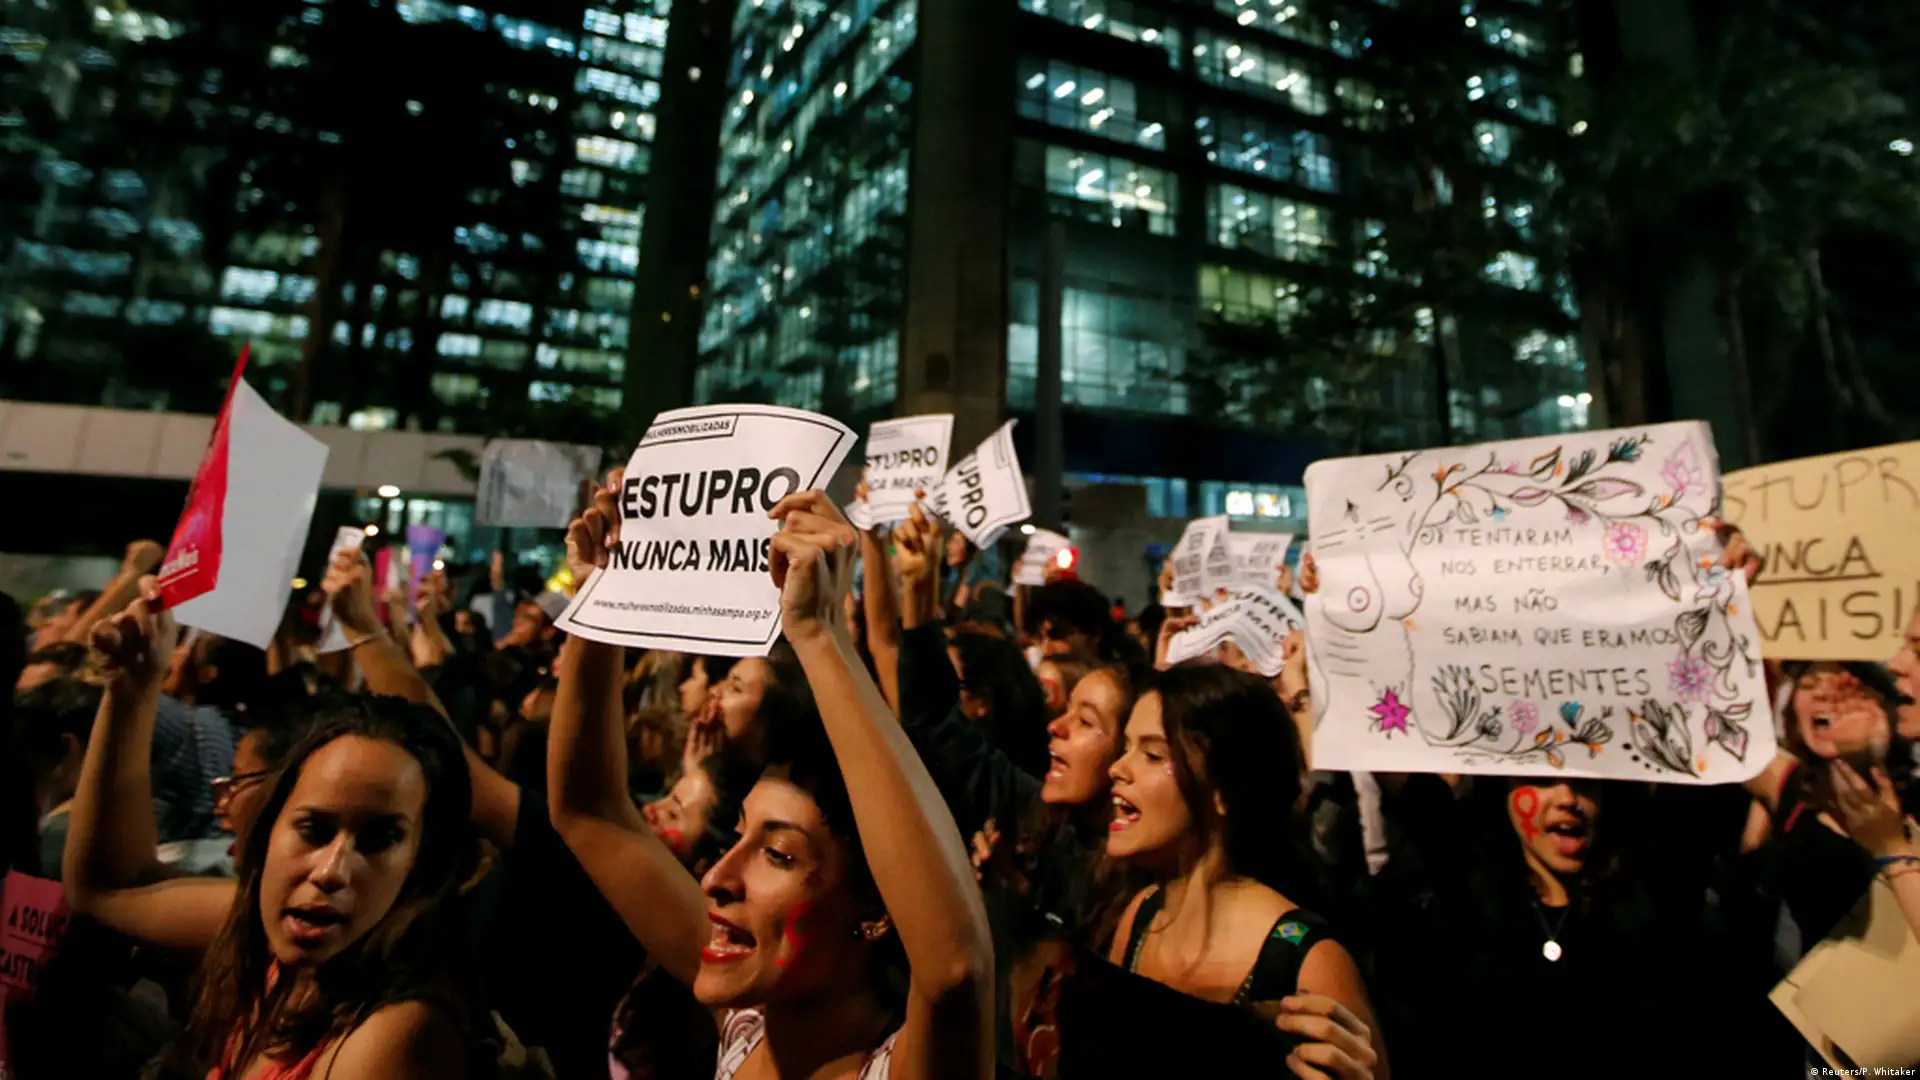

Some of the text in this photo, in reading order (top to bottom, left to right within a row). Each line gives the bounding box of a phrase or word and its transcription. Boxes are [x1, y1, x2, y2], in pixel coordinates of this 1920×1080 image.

[621, 467, 800, 520] ESTUPRO
[1454, 527, 1573, 547] TENTARAM
[612, 538, 772, 573] NUNCA MAIS
[1441, 556, 1610, 576] NOS ENTERRAR,
[1454, 588, 1559, 613] MAS NÃO
[1443, 626, 1678, 648] SABIAM QUE ERAMOS
[1479, 663, 1652, 700] SEMENTES
